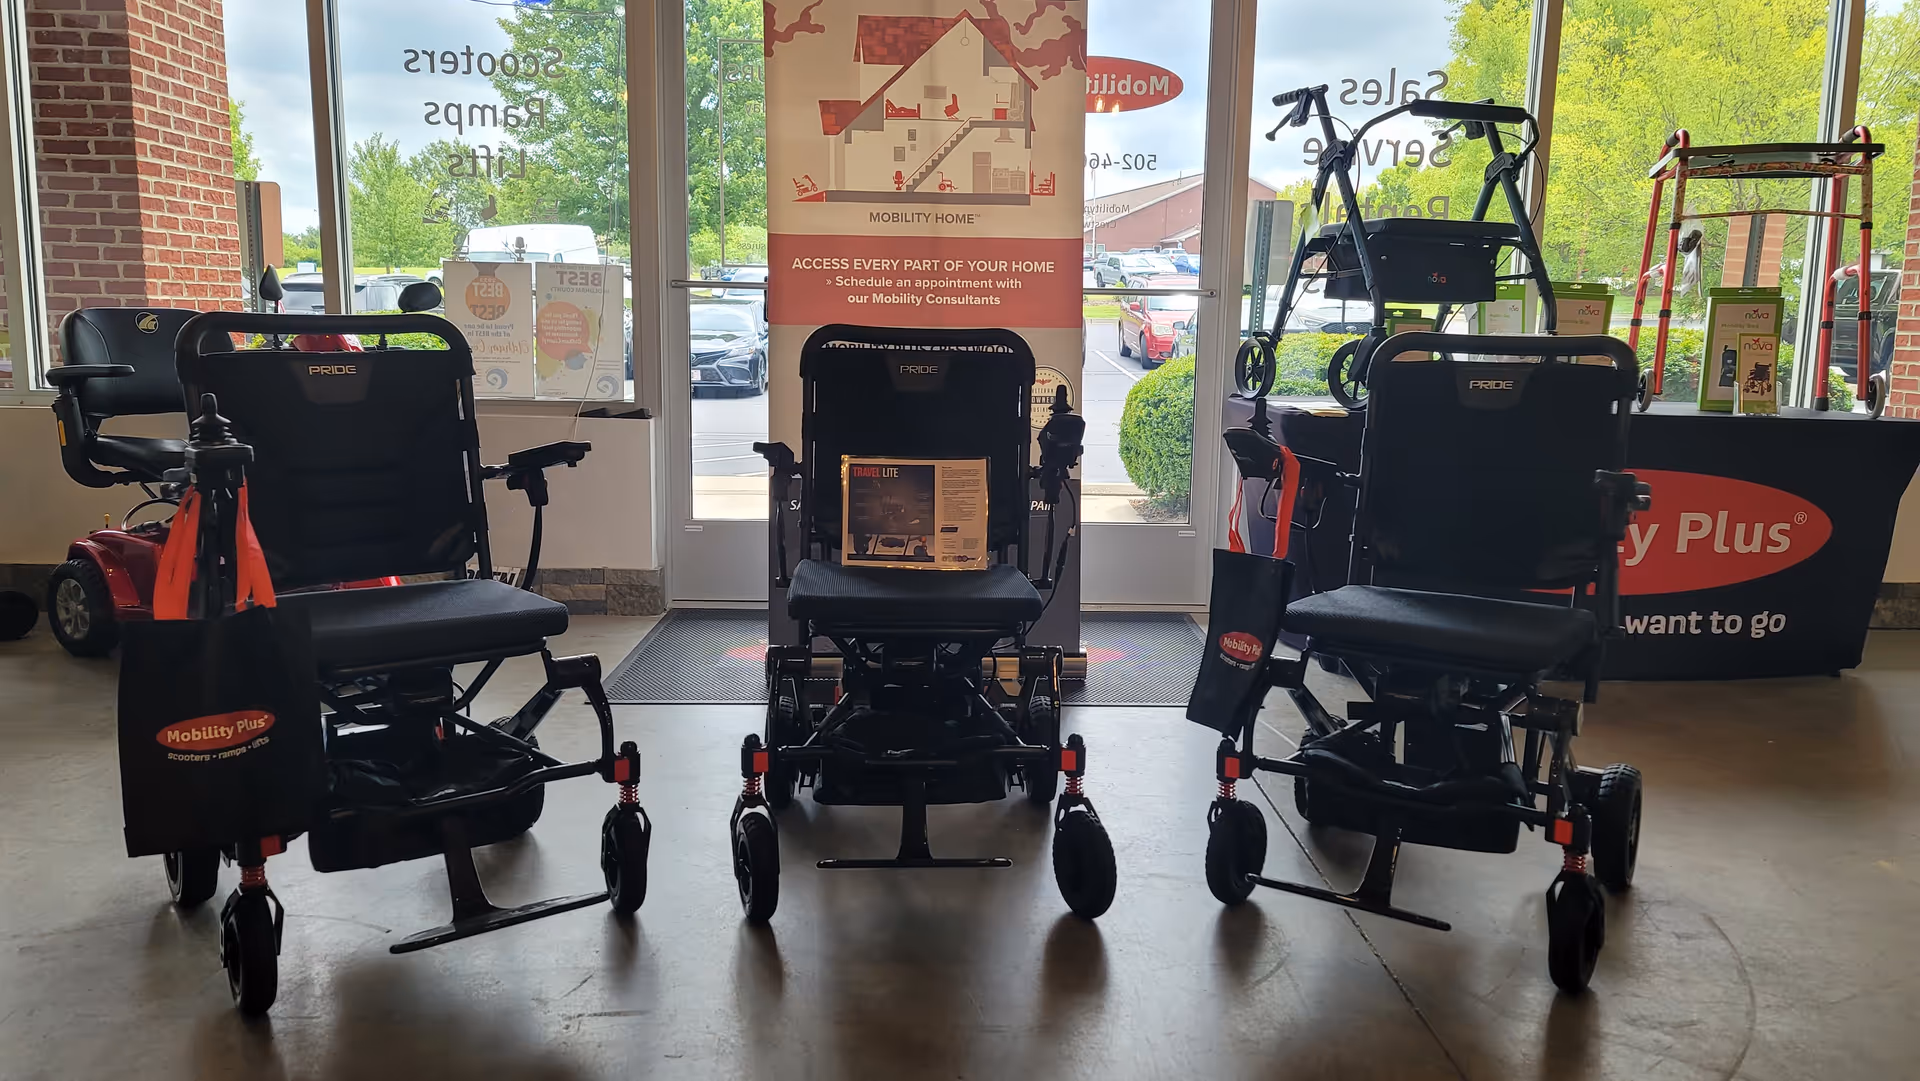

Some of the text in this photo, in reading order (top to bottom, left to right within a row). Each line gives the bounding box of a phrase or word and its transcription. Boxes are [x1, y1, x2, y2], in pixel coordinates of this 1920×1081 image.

[869, 212, 931, 223] MOBILITY
[791, 257, 1055, 273] ACCESS EVERY PART OF YOUR HOME
[835, 275, 1022, 290] Schedule an appointment with
[847, 292, 1001, 306] our Mobility Consultants
[1578, 306, 1600, 316] nova
[1745, 310, 1769, 320] nova
[1744, 339, 1772, 351] nova
[308, 365, 357, 375] PRIDE
[900, 365, 939, 374] PRIDE
[1469, 379, 1514, 390] PRIDE
[853, 466, 899, 478] TRAVEL LITE
[1625, 610, 1787, 639] want to go
[1223, 637, 1252, 656] Mobility
[167, 718, 266, 743] Mobility Plus
[168, 736, 270, 762] scooters ramps lifts
